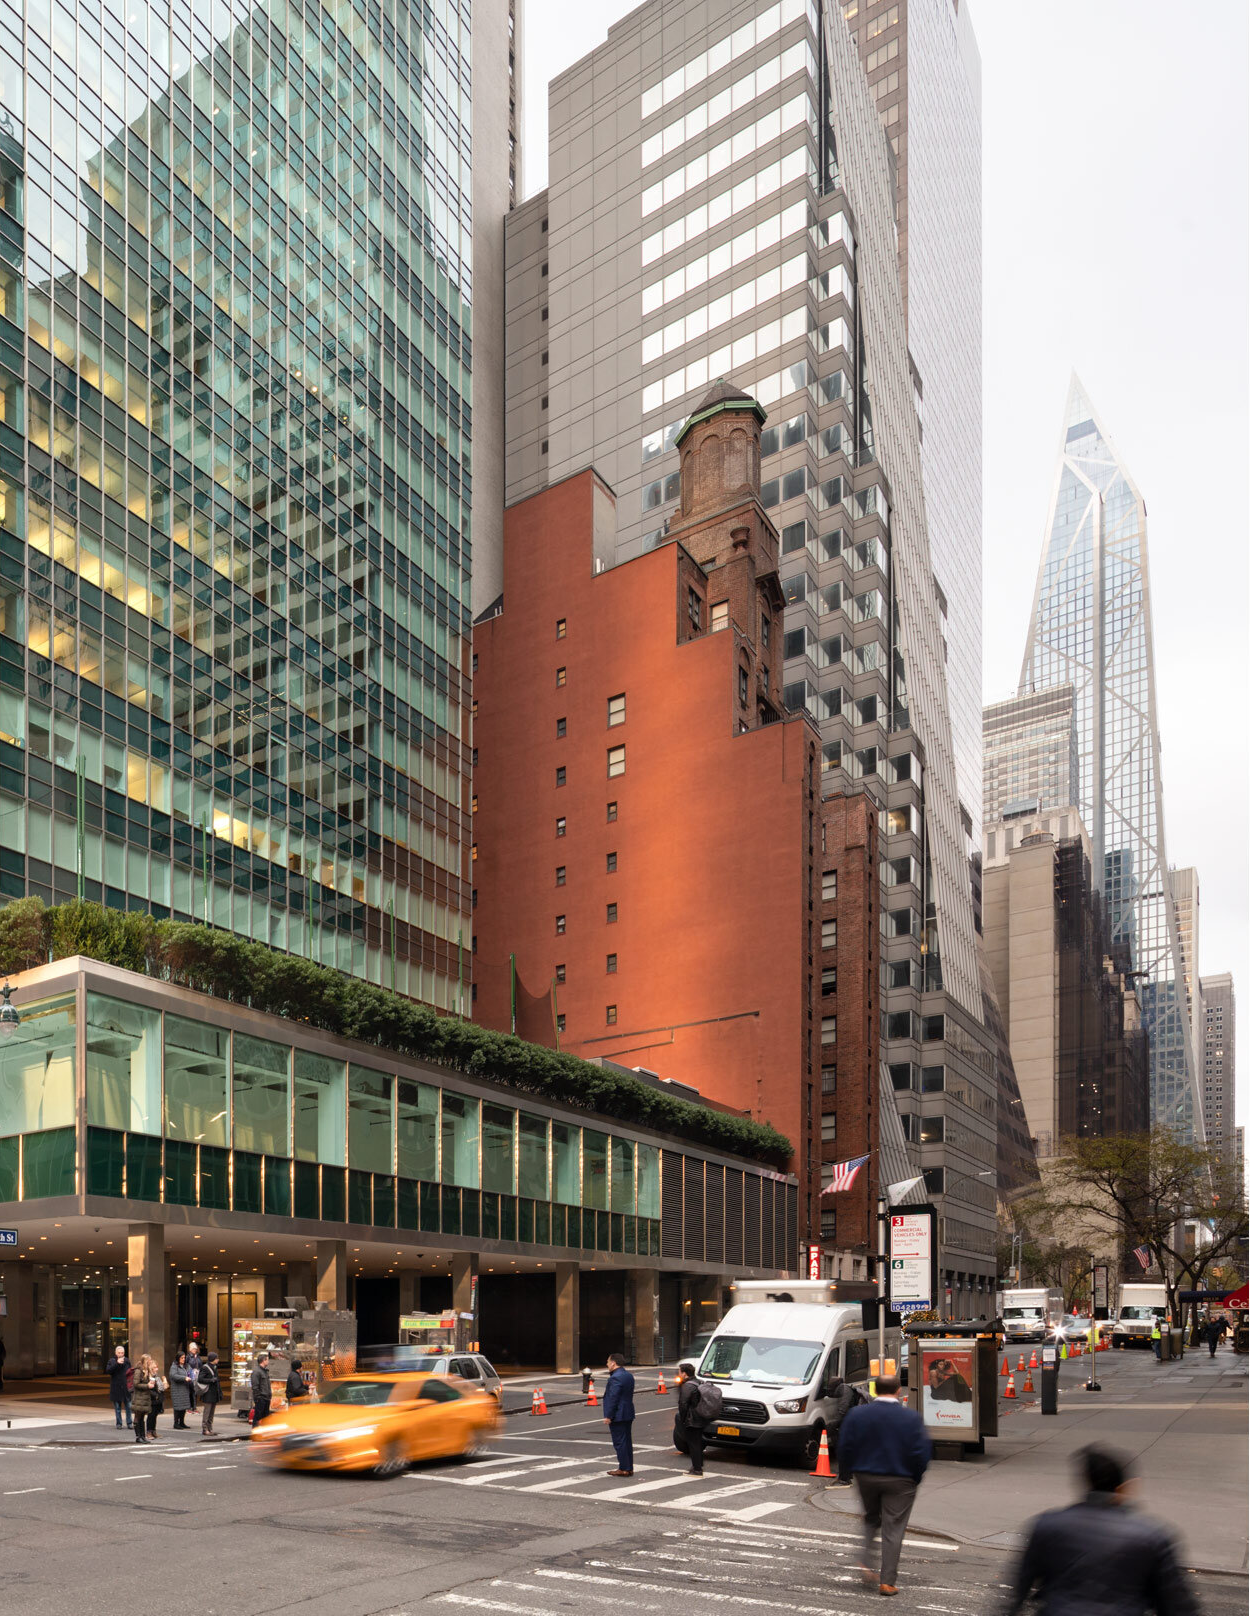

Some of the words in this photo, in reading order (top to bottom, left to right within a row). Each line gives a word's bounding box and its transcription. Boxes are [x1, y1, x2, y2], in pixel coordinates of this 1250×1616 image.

[895, 1217, 902, 1226] 3
[6, 1233, 14, 1242] St
[810, 1252, 818, 1280] PARK
[895, 1260, 902, 1269] 6
